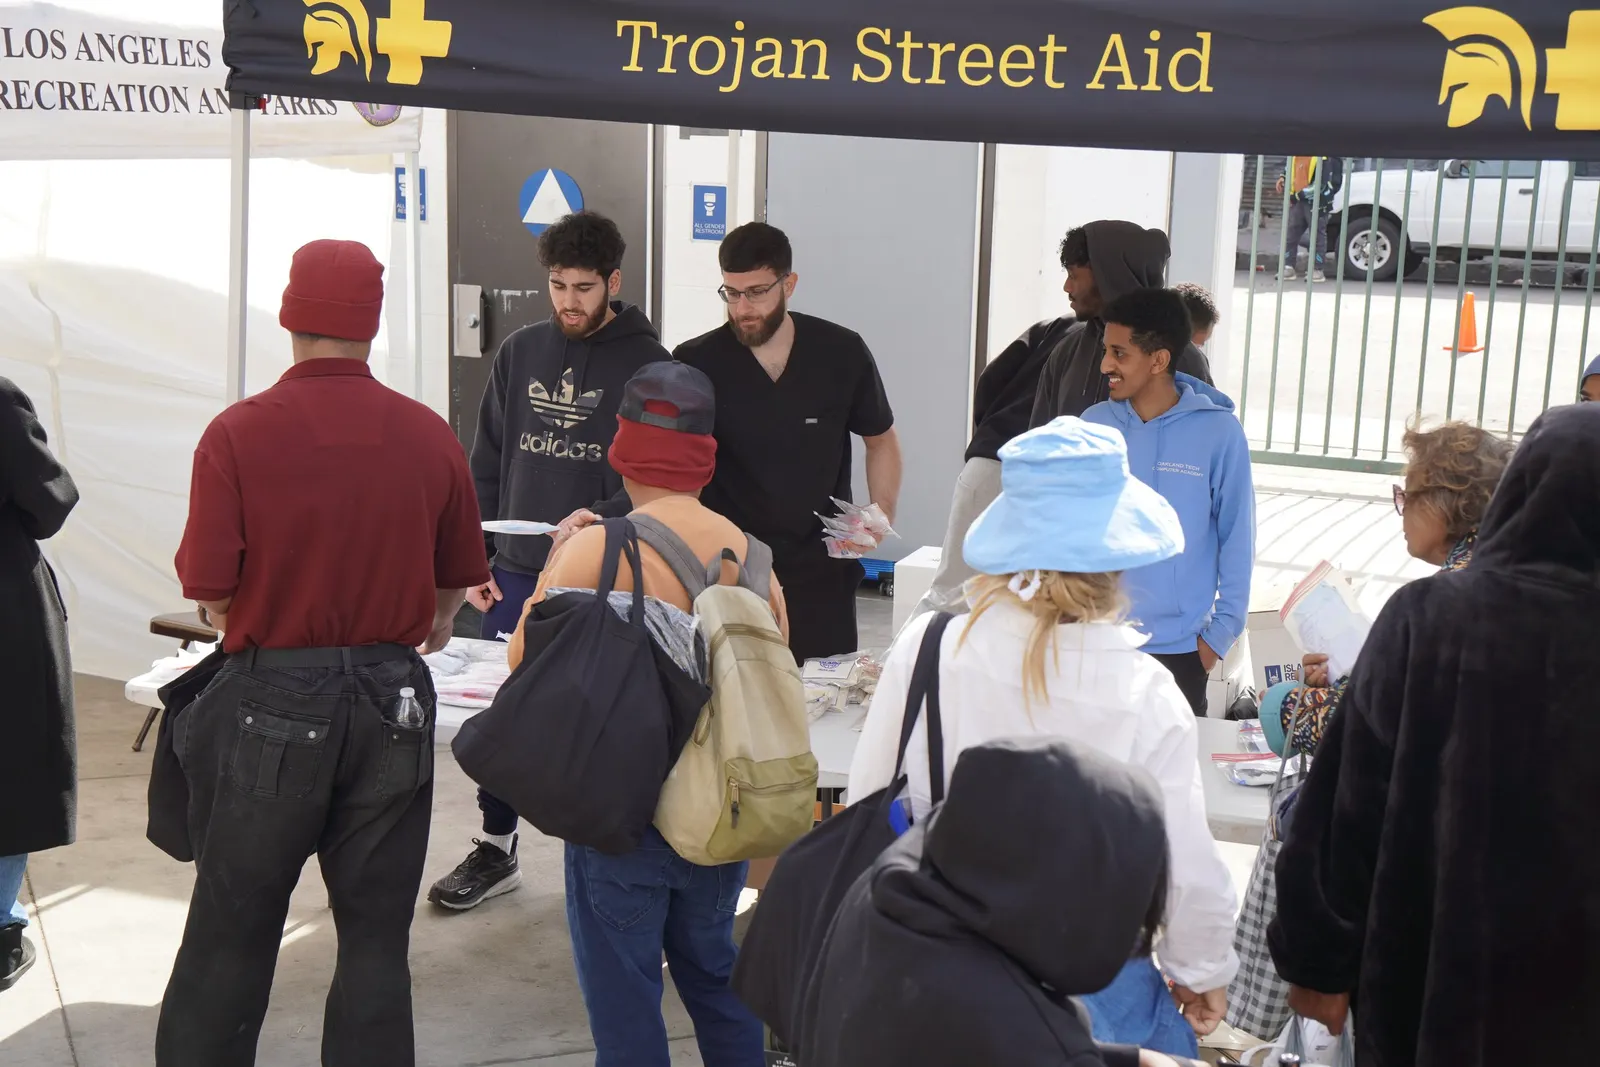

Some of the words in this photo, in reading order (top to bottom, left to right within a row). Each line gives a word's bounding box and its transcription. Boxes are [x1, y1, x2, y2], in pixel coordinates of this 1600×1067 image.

[2, 27, 67, 60] LOS
[75, 32, 211, 68] ANGELES
[616, 19, 830, 93] Trojan
[852, 26, 1068, 89] Street
[1086, 29, 1214, 93] Aid
[0, 79, 190, 114] RECREATION
[198, 86, 231, 115] AN
[695, 227, 724, 235] RESTROOM
[519, 430, 602, 462] adidas
[1151, 465, 1180, 473] COMPUTER
[1179, 468, 1204, 478] ACADEMY
[1157, 461, 1184, 469] OAKLAND
[1185, 463, 1200, 471] TECH
[1283, 663, 1302, 673] ISLA
